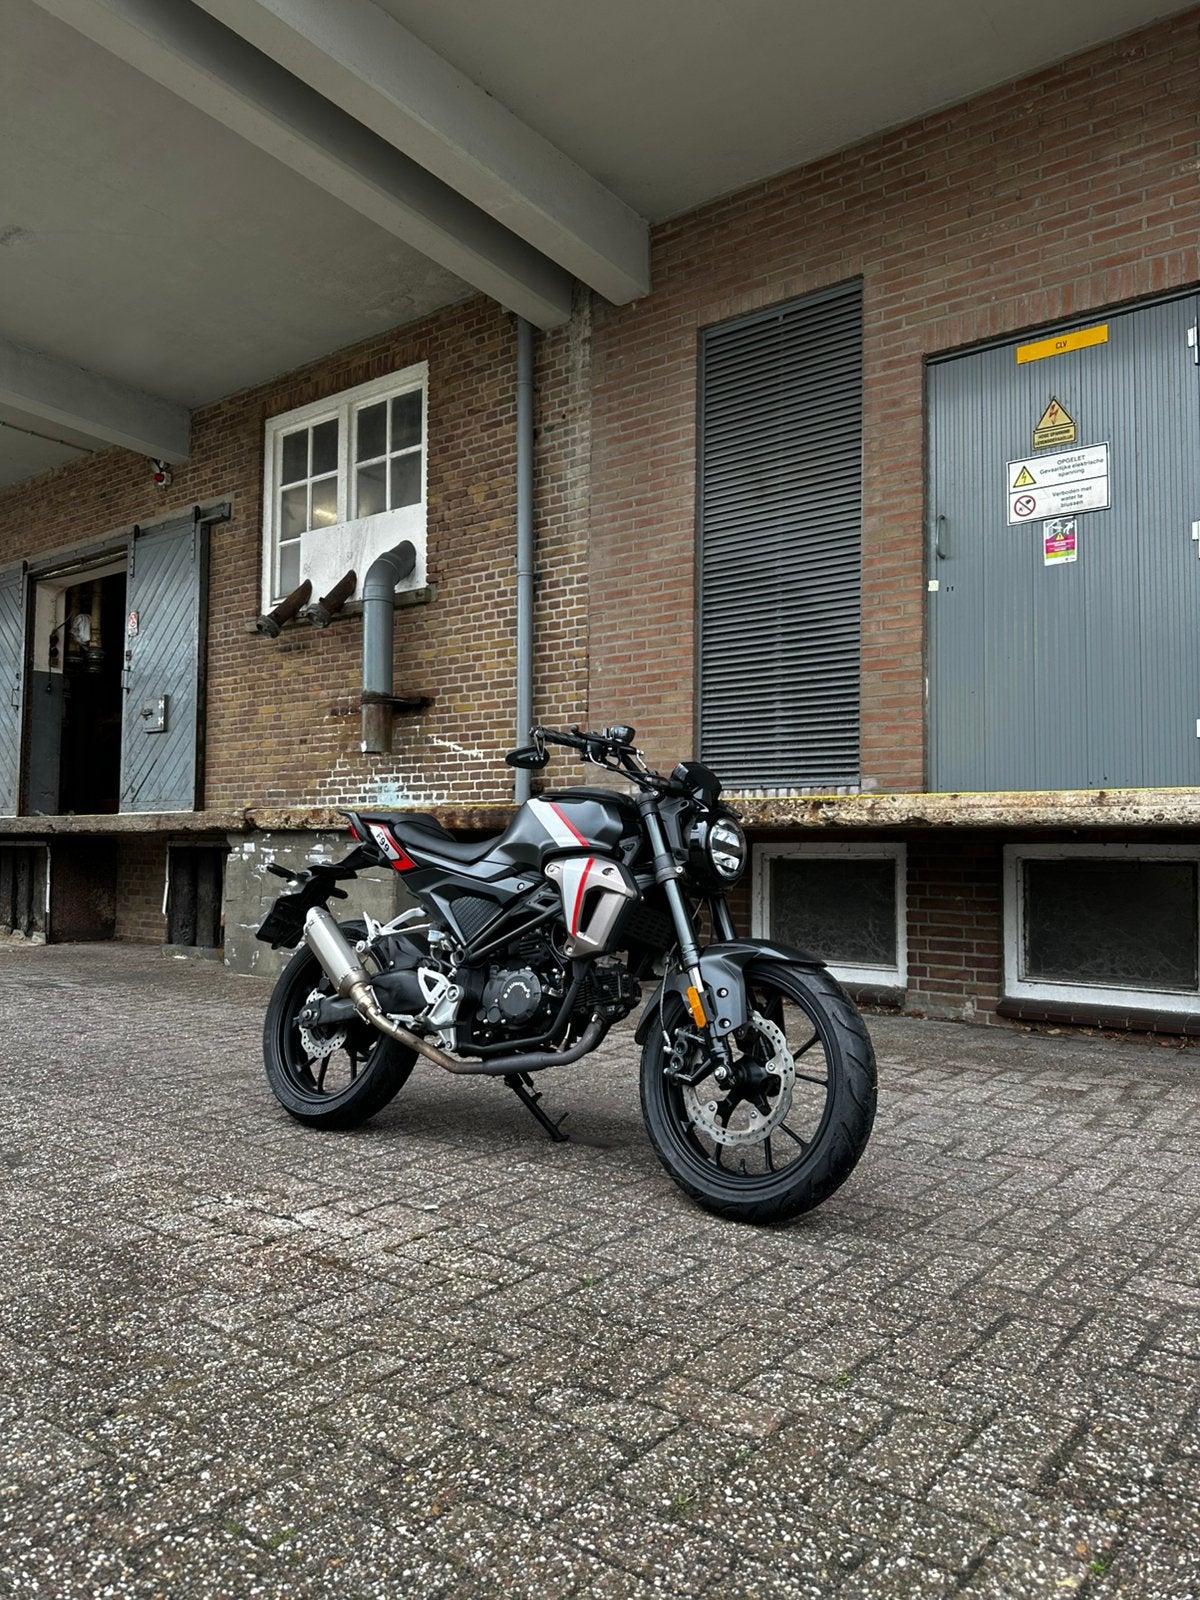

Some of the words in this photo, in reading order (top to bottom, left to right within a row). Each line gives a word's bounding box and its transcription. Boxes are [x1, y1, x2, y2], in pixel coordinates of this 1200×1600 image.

[1055, 340, 1068, 349] CLV
[1057, 455, 1086, 465] OPGELET
[1040, 465, 1072, 475] Gevaarlijke
[1072, 458, 1104, 468] elektrische
[1058, 468, 1085, 477] spanning
[1052, 487, 1079, 497] Verboden
[376, 831, 390, 852] F99
